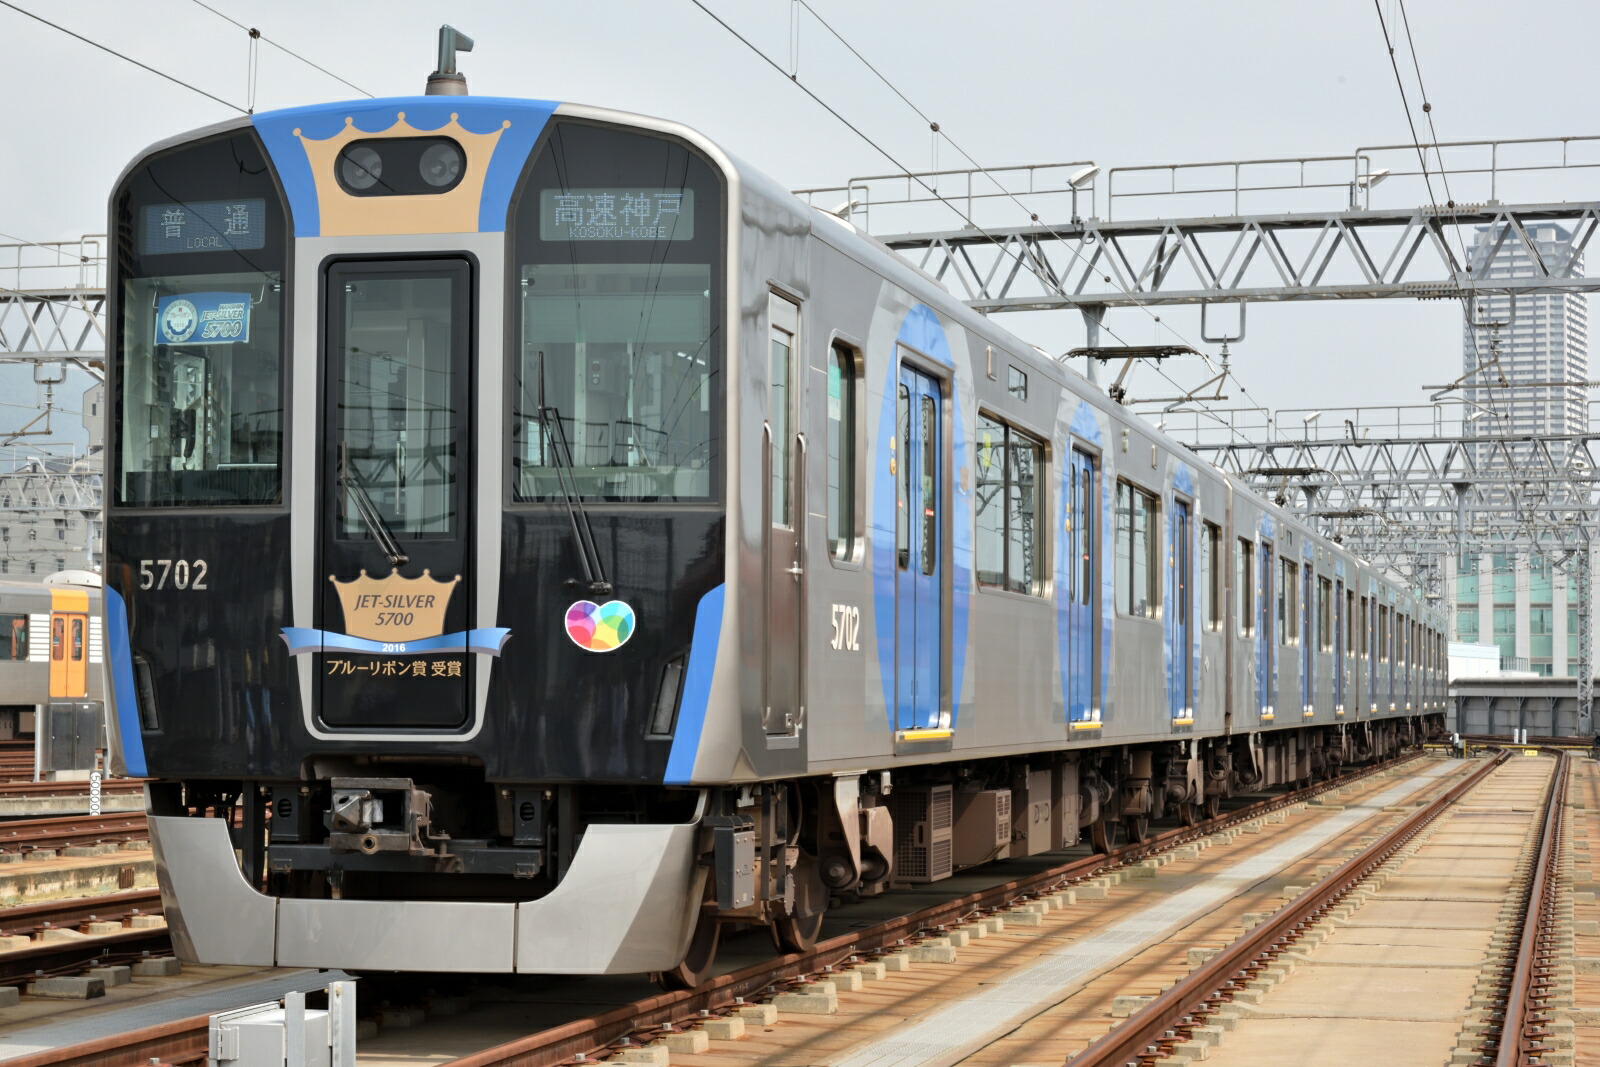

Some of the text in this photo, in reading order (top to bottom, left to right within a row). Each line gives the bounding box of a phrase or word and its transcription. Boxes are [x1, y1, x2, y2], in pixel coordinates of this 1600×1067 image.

[553, 192, 683, 226] 高速神戸
[569, 226, 667, 238] KOSOKU-KOBE
[186, 236, 223, 249] LOCAL
[202, 320, 243, 338] 5700
[140, 559, 207, 591] 5702
[354, 594, 435, 611] JET-SILVER
[374, 612, 414, 626] 5700
[830, 603, 860, 651] 5702
[382, 643, 406, 652] 2016
[326, 660, 462, 677] ブルーリボン賞 受賞
